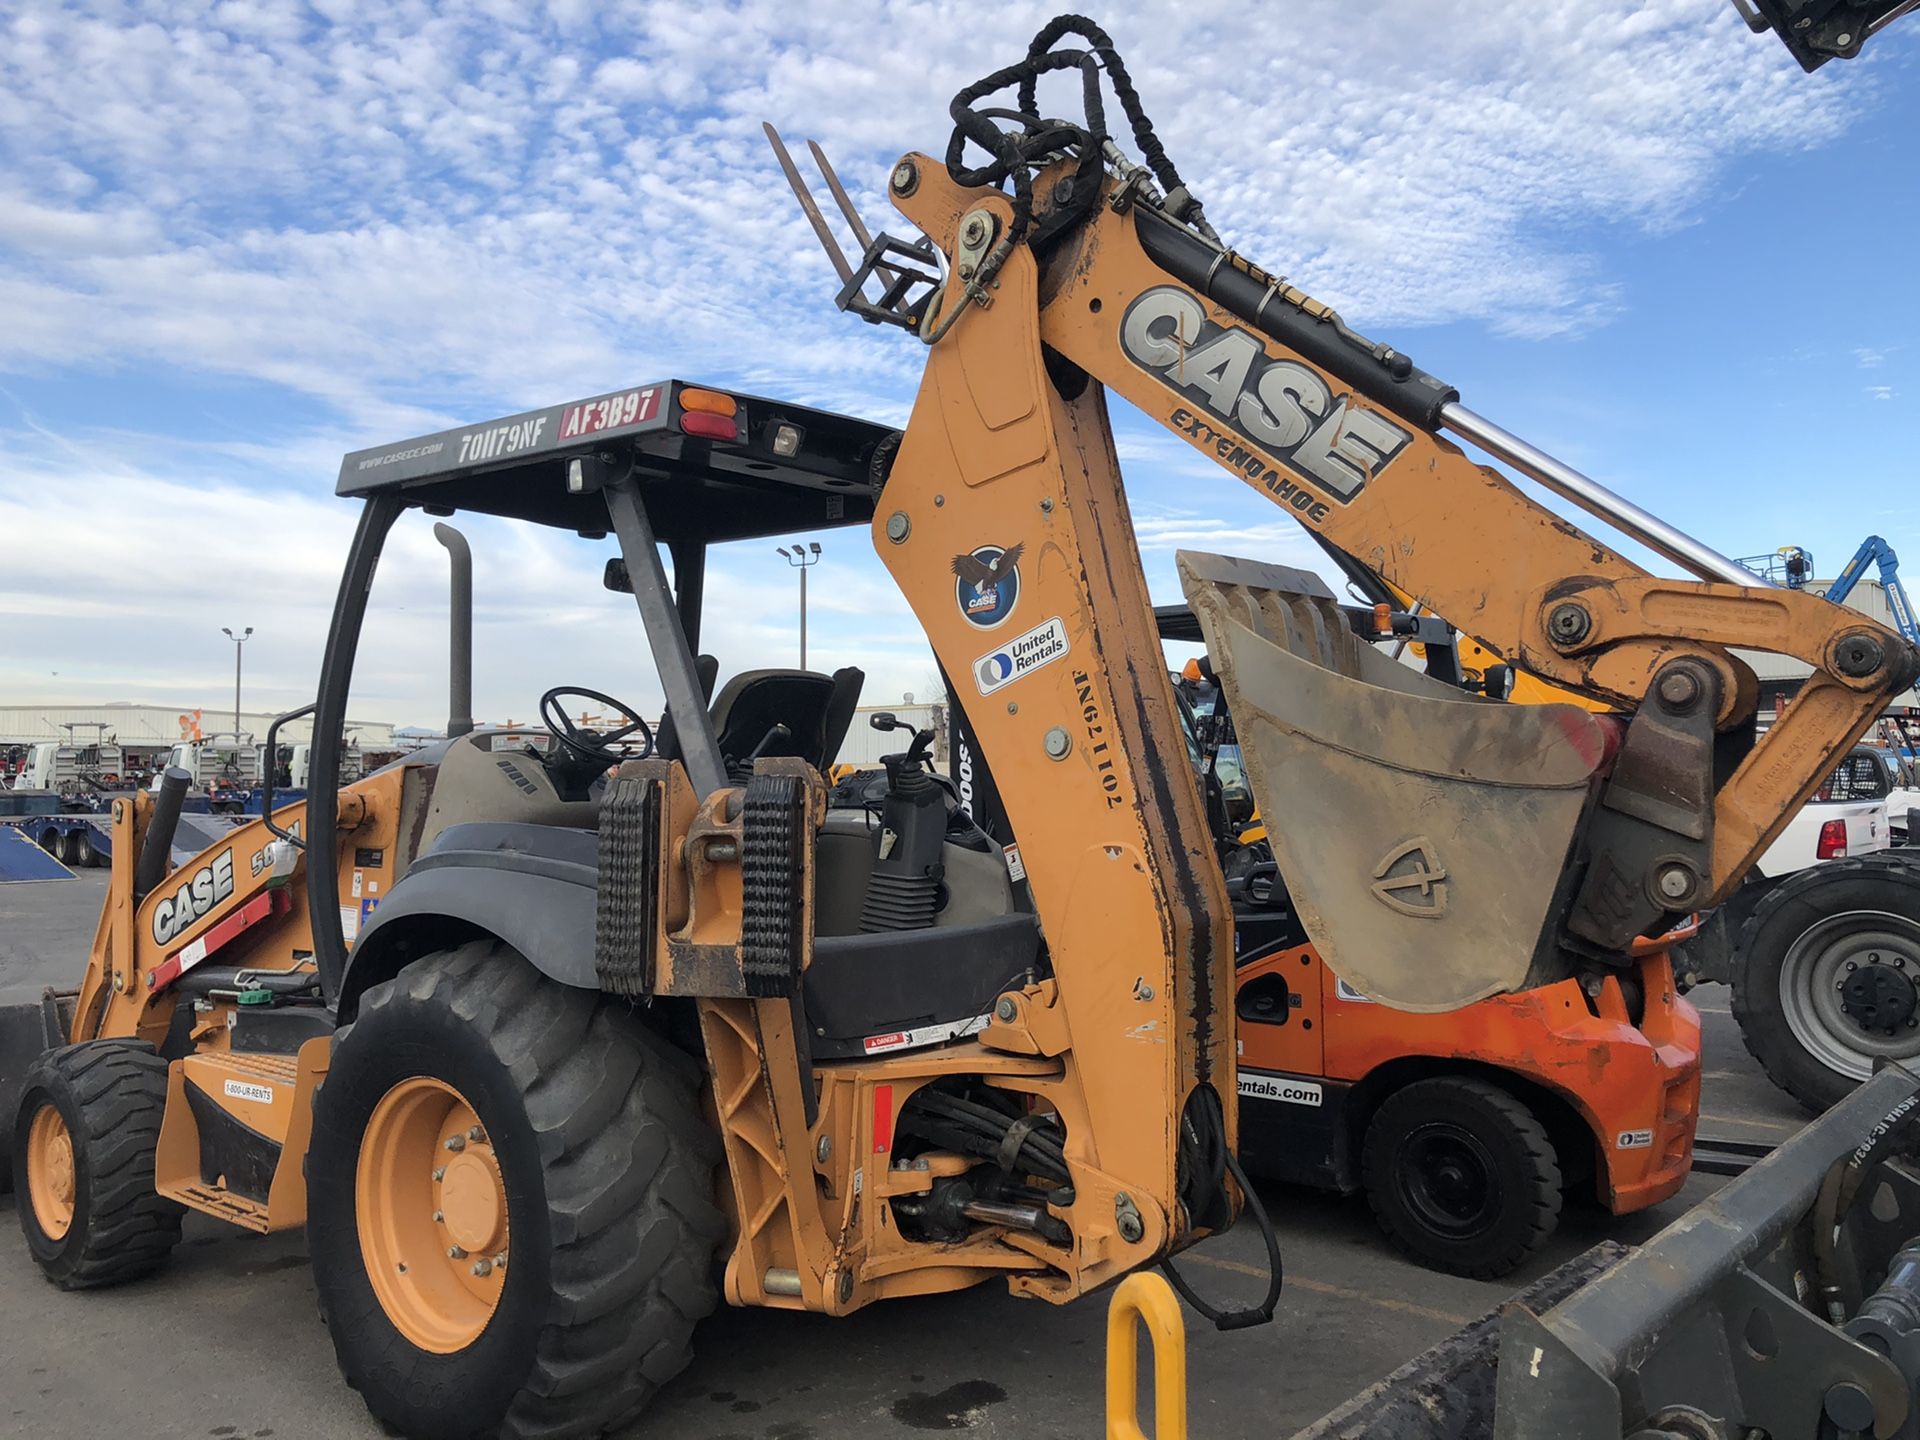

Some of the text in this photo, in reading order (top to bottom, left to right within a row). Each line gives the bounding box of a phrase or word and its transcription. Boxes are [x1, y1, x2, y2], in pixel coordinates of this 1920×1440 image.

[565, 389, 655, 437] AF3B97
[1119, 284, 1412, 506] CASE
[1170, 407, 1330, 524] EXTENDAHOE
[968, 594, 997, 608] CASE
[1012, 625, 1054, 658] United
[1016, 639, 1063, 672] Rentals
[959, 728, 973, 820] DOOS
[153, 846, 234, 945] CASE
[1884, 1095, 1919, 1123] MSHA
